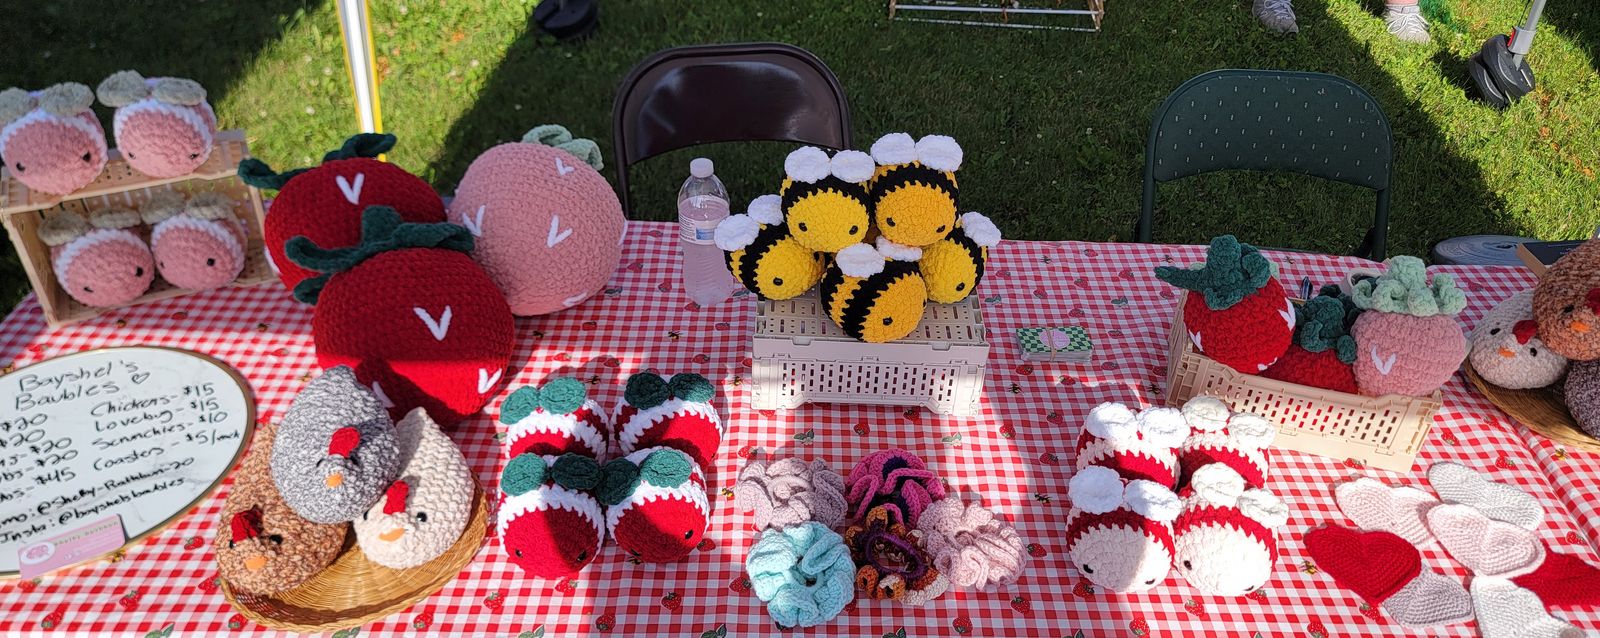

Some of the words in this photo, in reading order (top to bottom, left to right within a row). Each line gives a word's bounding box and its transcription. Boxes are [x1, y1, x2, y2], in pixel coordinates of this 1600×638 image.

[16, 381, 120, 411] Baubles
[184, 382, 215, 396] $15
[190, 397, 219, 411] $15
[199, 411, 228, 424] $10
[94, 447, 164, 470] Coasters
